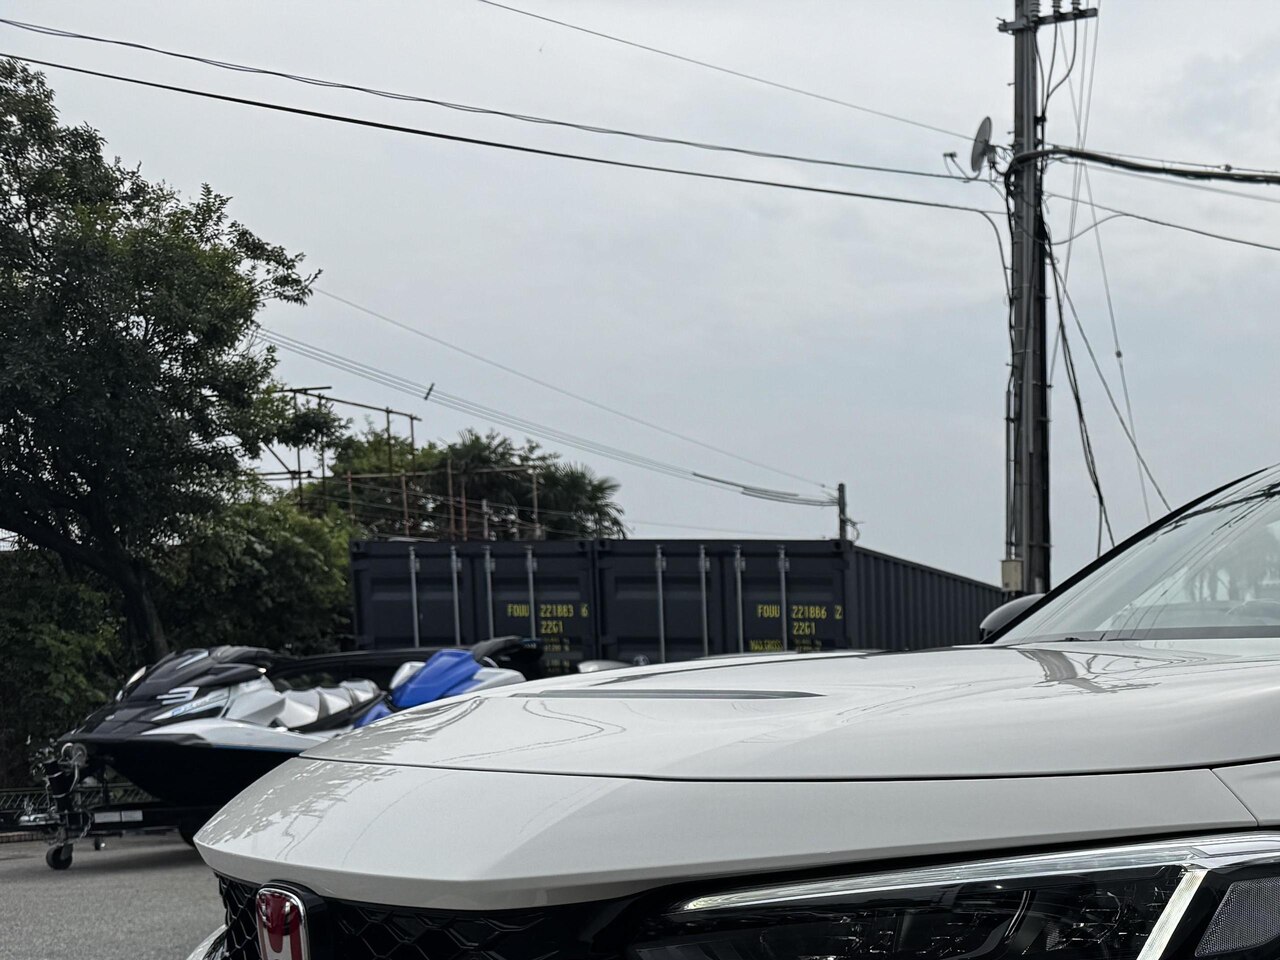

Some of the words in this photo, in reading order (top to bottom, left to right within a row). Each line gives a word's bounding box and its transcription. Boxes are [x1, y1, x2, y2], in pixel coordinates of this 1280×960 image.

[581, 604, 589, 618] 6
[757, 604, 781, 618] FOUU
[791, 605, 828, 619] 221886
[834, 605, 844, 620] 2
